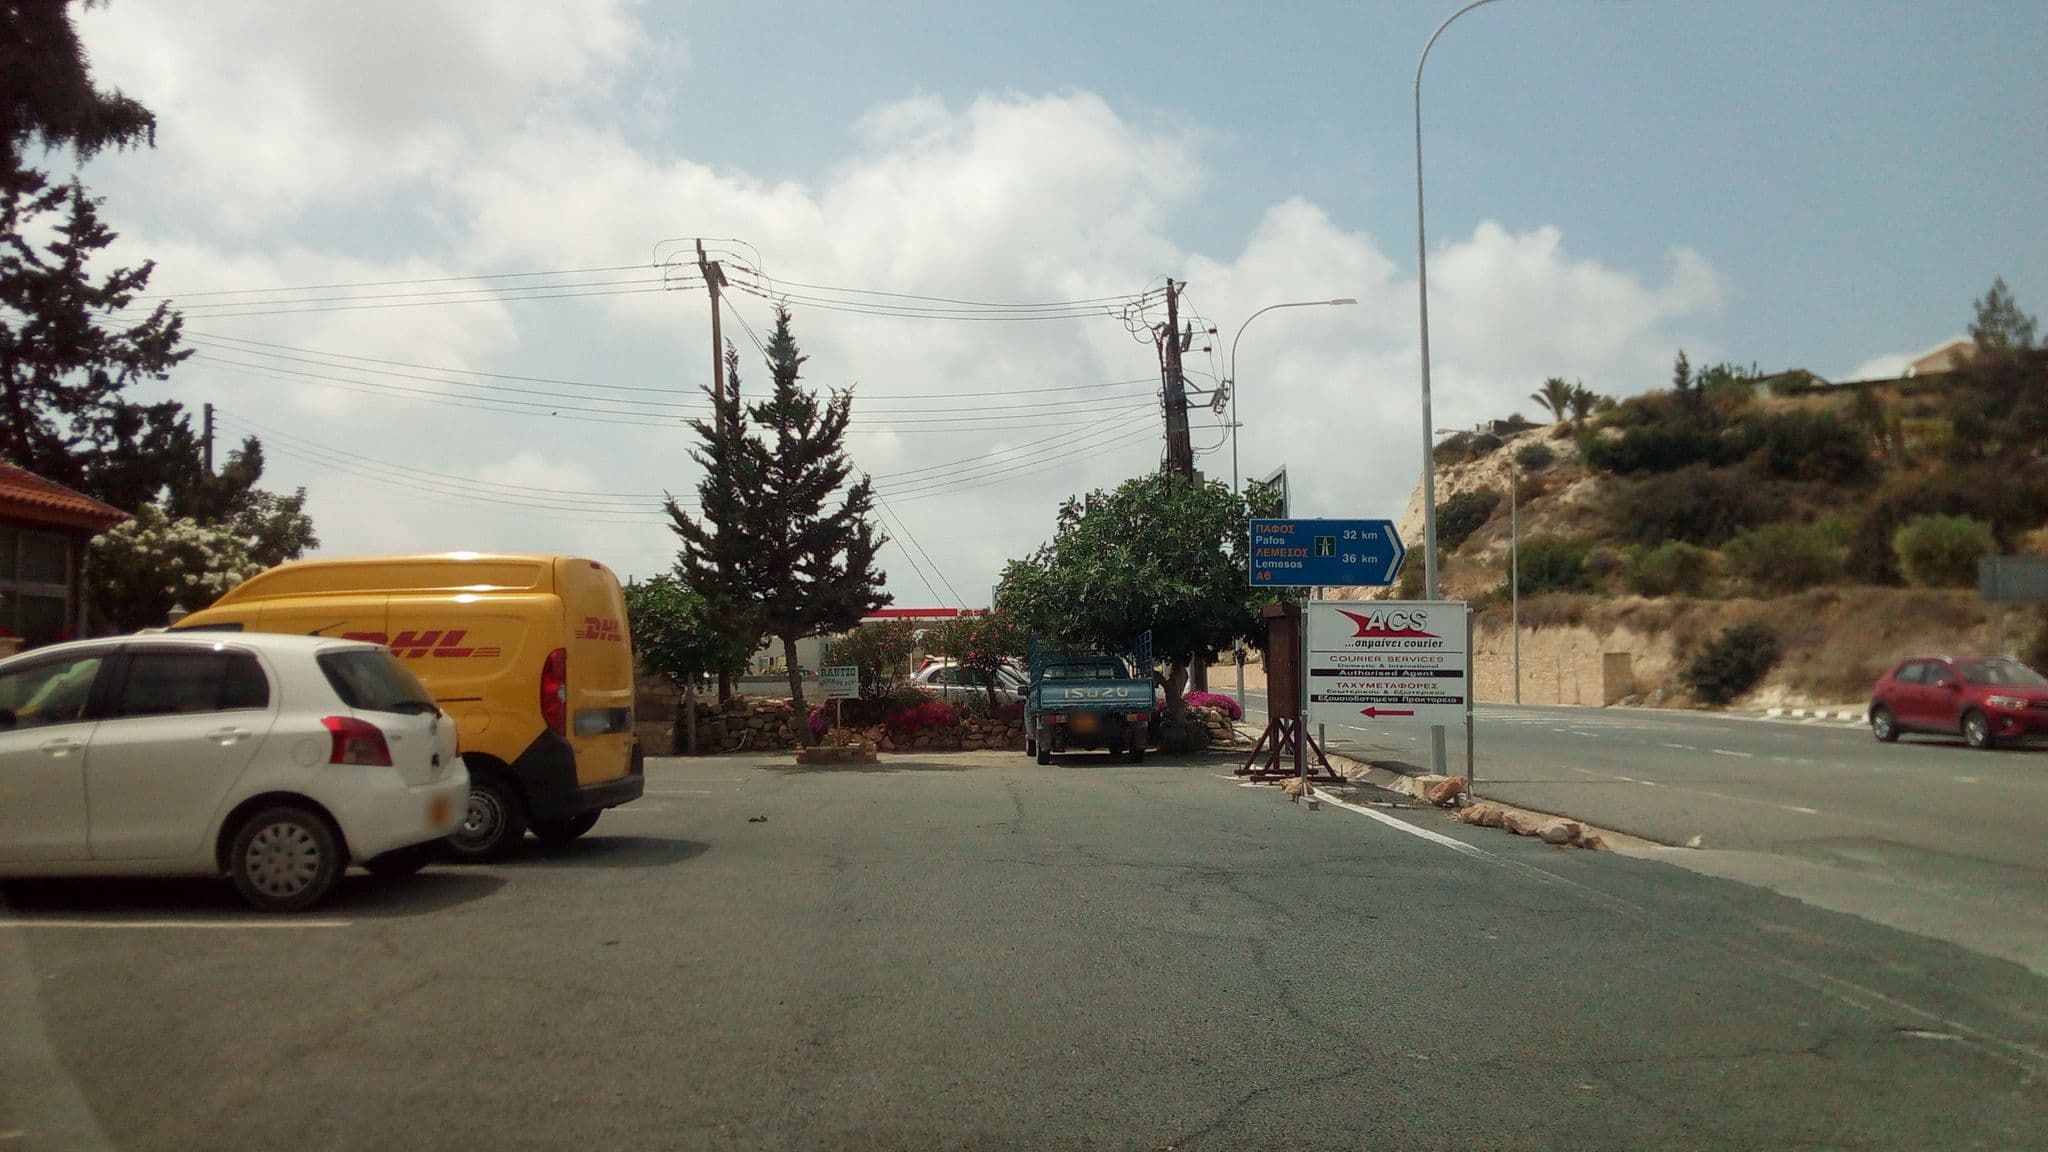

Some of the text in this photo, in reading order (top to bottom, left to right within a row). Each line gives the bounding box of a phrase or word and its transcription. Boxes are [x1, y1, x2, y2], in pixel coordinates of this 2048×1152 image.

[1255, 524, 1295, 535] ΠΑΦΟΣ
[1343, 530, 1378, 540] 32 km
[1255, 536, 1285, 545] Pafos
[1256, 548, 1309, 558] ΛΕΜΕΣΟΣ
[1342, 554, 1378, 564] 36 km
[1255, 560, 1303, 569] Lemesos
[1256, 571, 1272, 581] A6
[1364, 609, 1428, 632] ACS
[580, 616, 623, 642] DHL
[1403, 638, 1443, 648] courier
[1329, 655, 1444, 663] COURIER SERVICES
[1339, 669, 1434, 678] Authorised Agent
[1064, 687, 1129, 699] ISUZU
